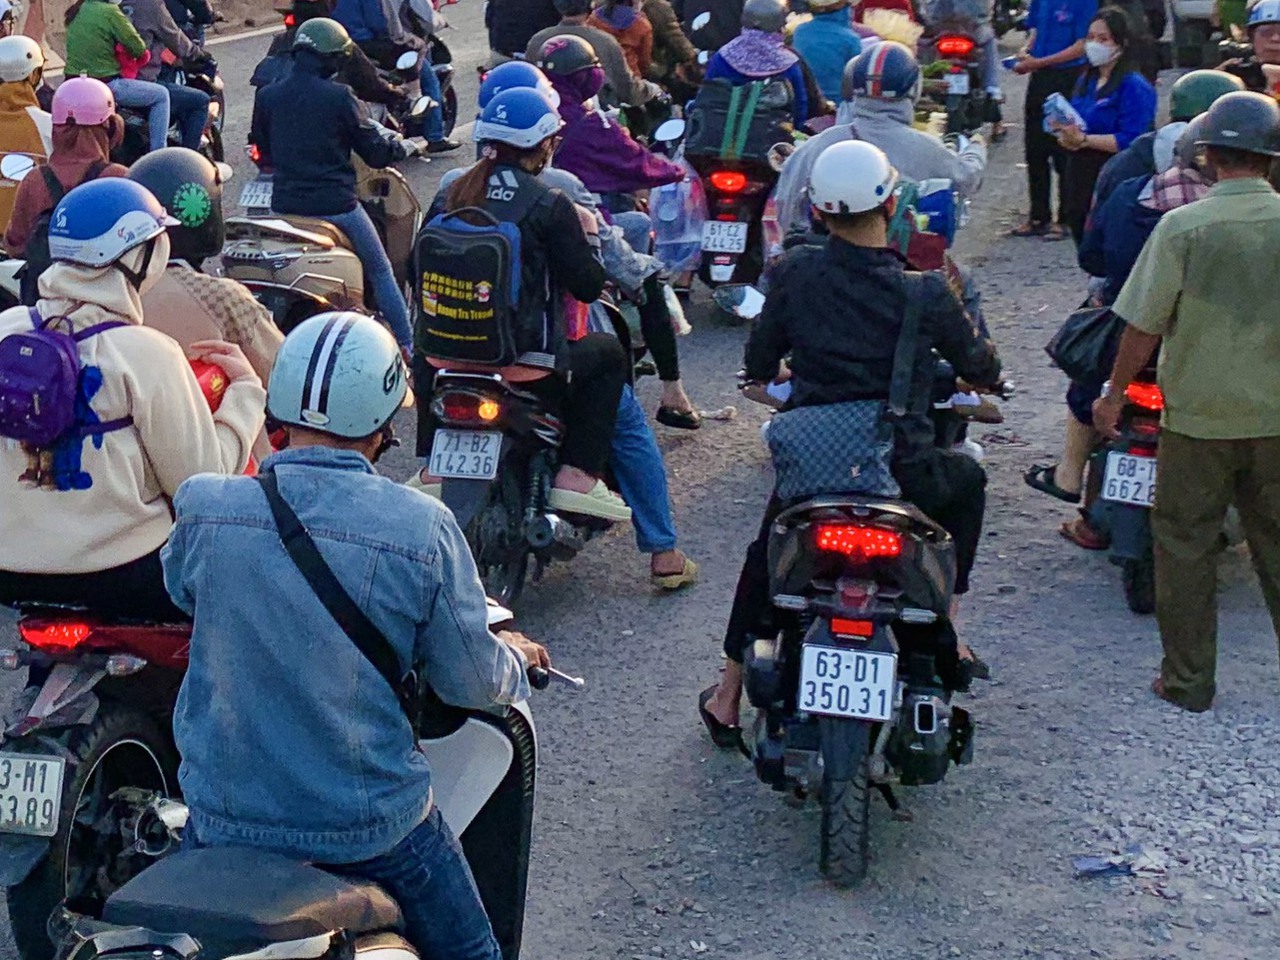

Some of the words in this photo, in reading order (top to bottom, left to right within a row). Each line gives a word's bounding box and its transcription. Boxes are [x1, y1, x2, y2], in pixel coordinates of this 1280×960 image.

[442, 431, 491, 454] 71-B2
[435, 452, 494, 475] 142.36
[1117, 456, 1159, 482] 68-T
[815, 650, 880, 685] 63-D1
[803, 679, 888, 717] 350.31
